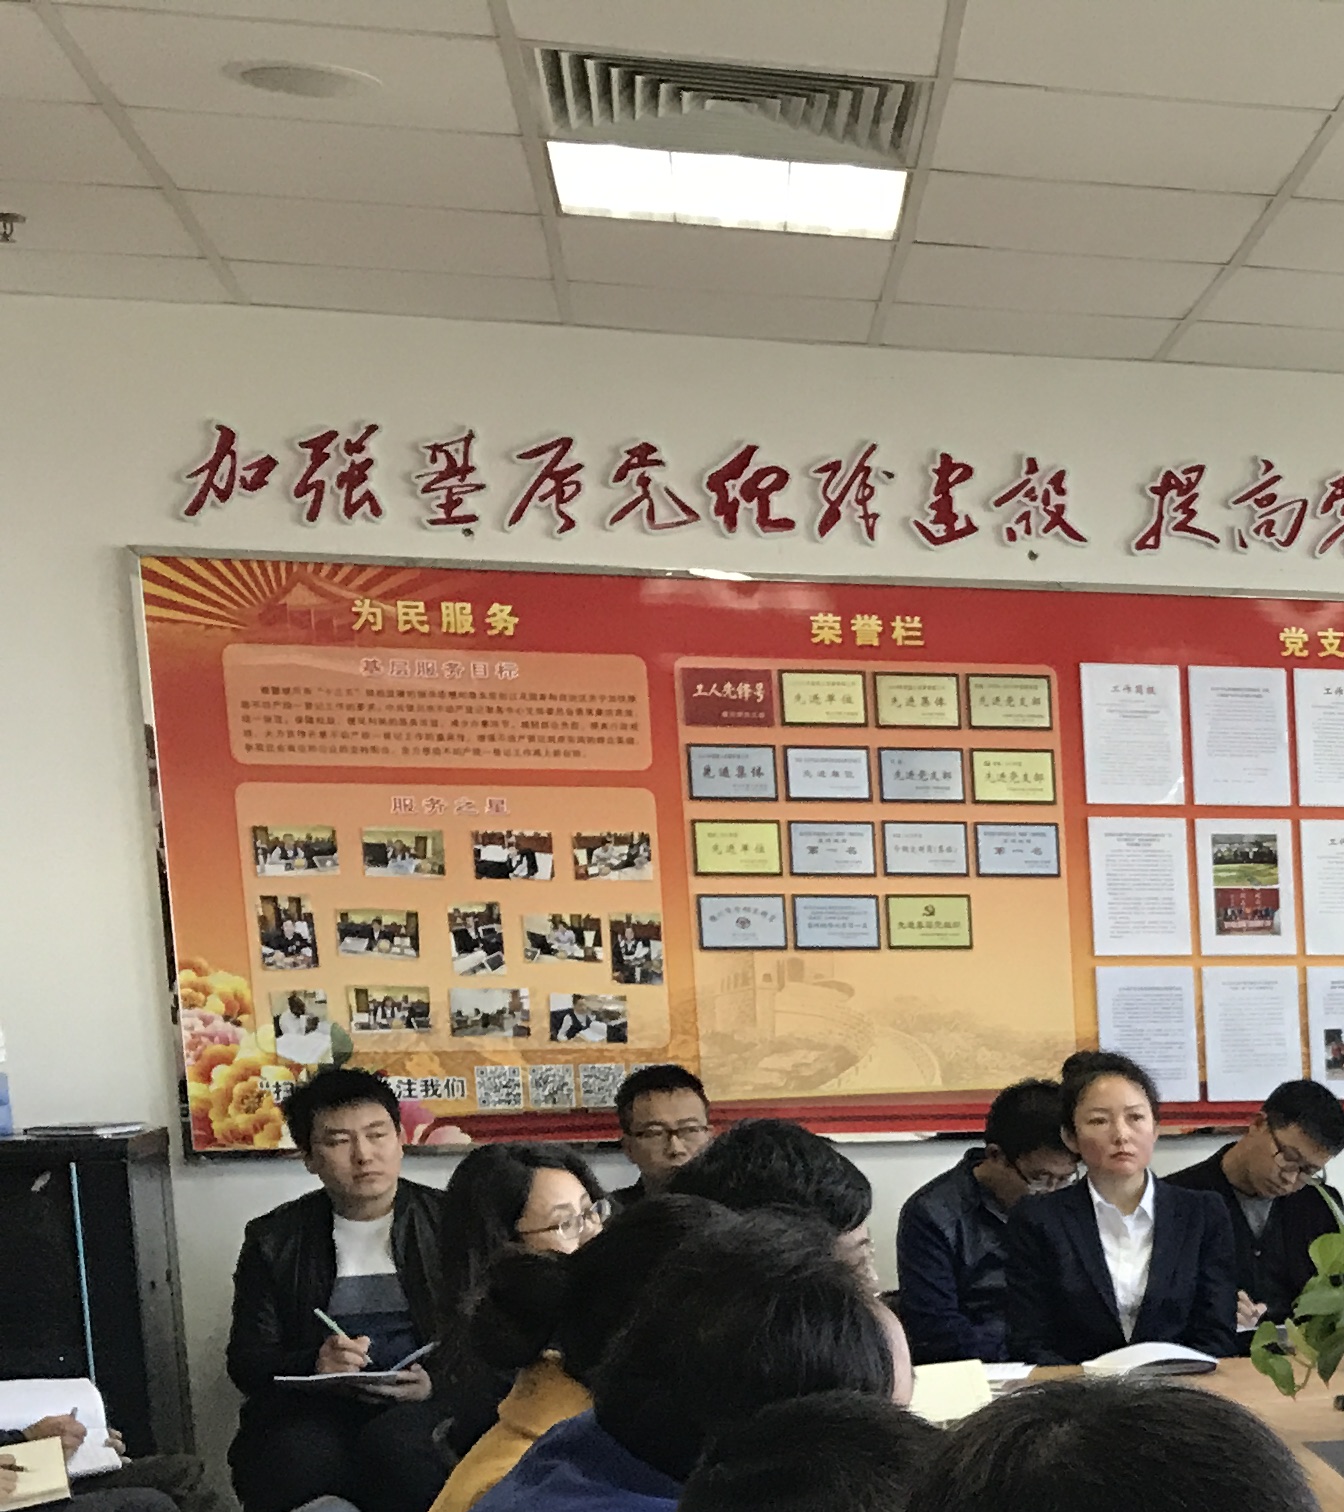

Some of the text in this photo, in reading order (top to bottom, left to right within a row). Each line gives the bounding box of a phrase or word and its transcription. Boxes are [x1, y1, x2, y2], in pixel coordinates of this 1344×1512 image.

[351, 597, 520, 636] 为民服务
[809, 612, 926, 648] 荣誉栏
[360, 656, 520, 681] 基层服务目标
[692, 681, 766, 703] 工人先锋号
[1111, 684, 1157, 696] 工作简报
[391, 796, 512, 816] 服务之星
